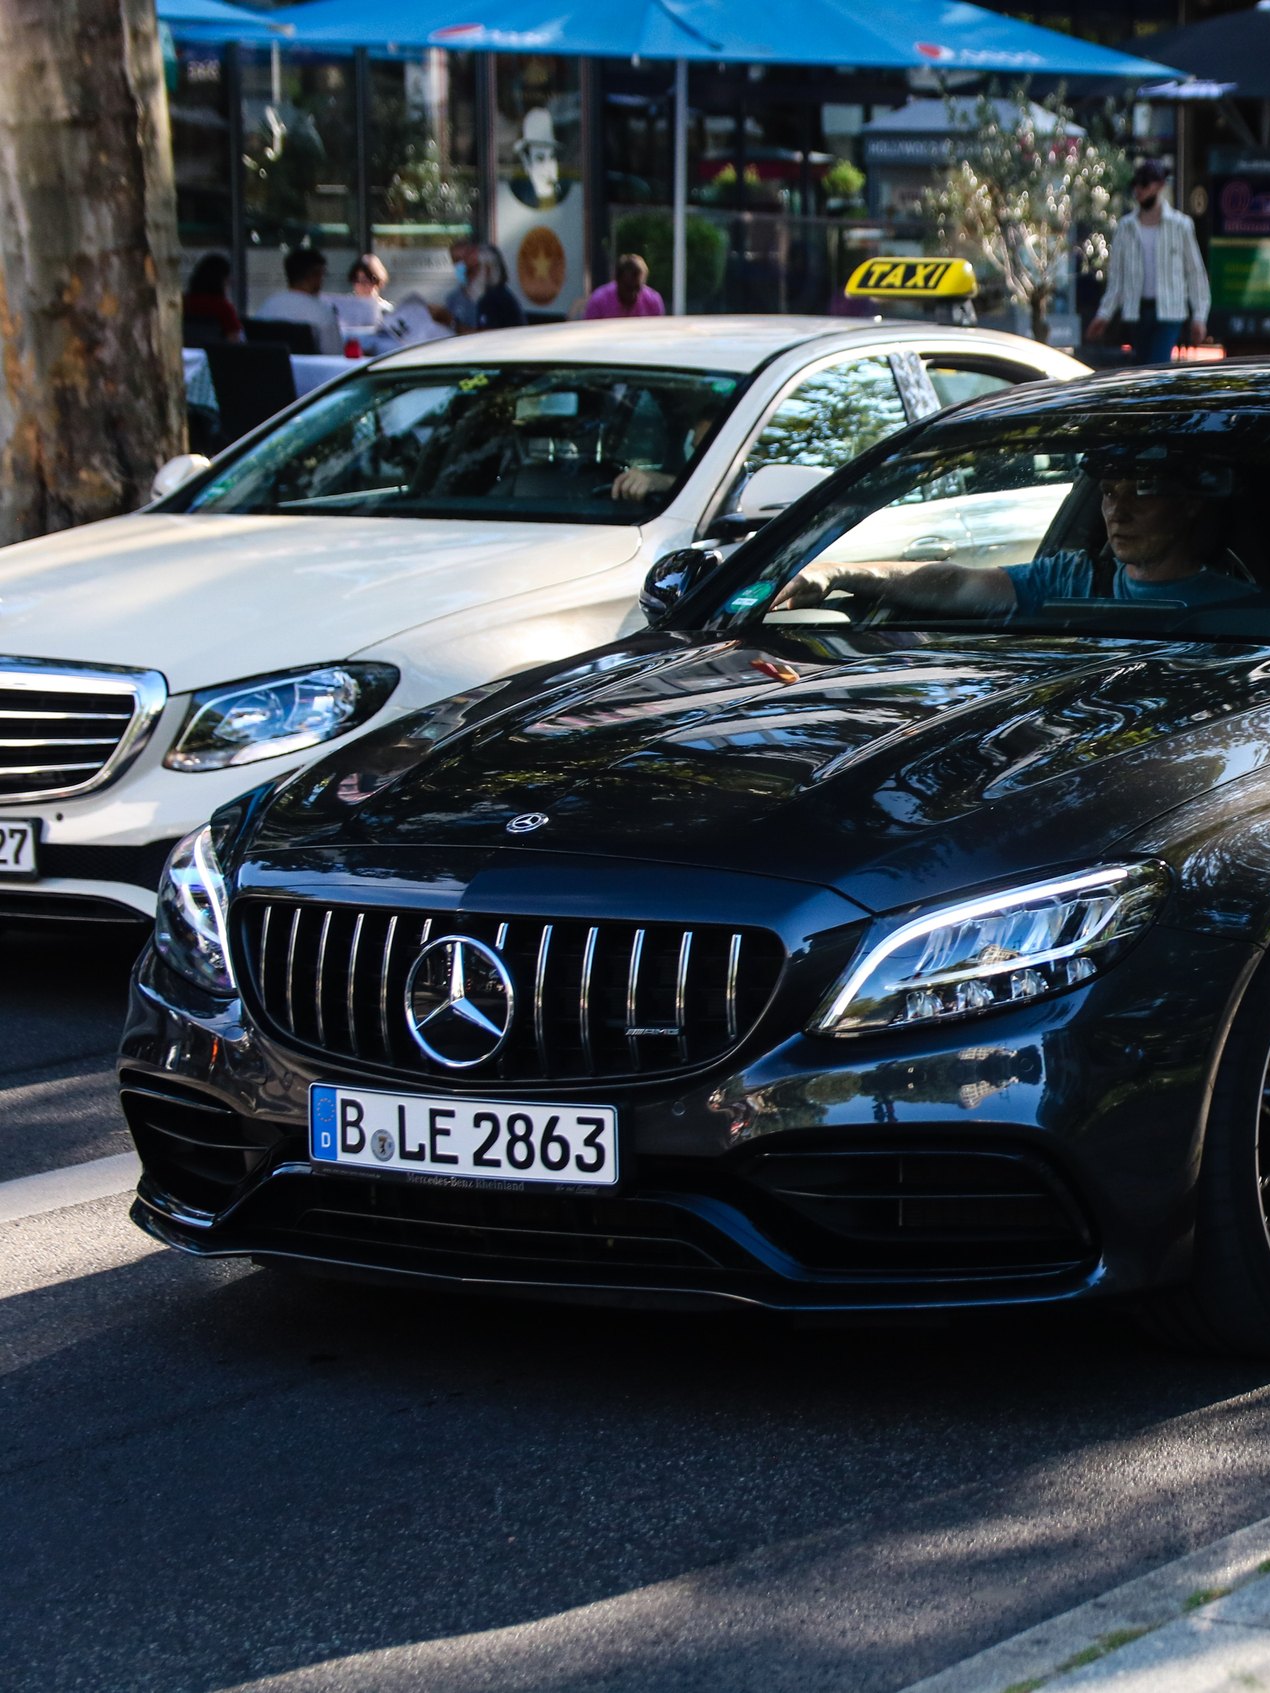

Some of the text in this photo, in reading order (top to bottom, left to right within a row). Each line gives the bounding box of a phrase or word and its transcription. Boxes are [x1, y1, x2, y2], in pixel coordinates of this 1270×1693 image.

[867, 263, 947, 288] TAXI
[321, 1097, 606, 1173] D B LE 2863
[406, 1171, 525, 1192] Mercedes-Benz Rheinland
